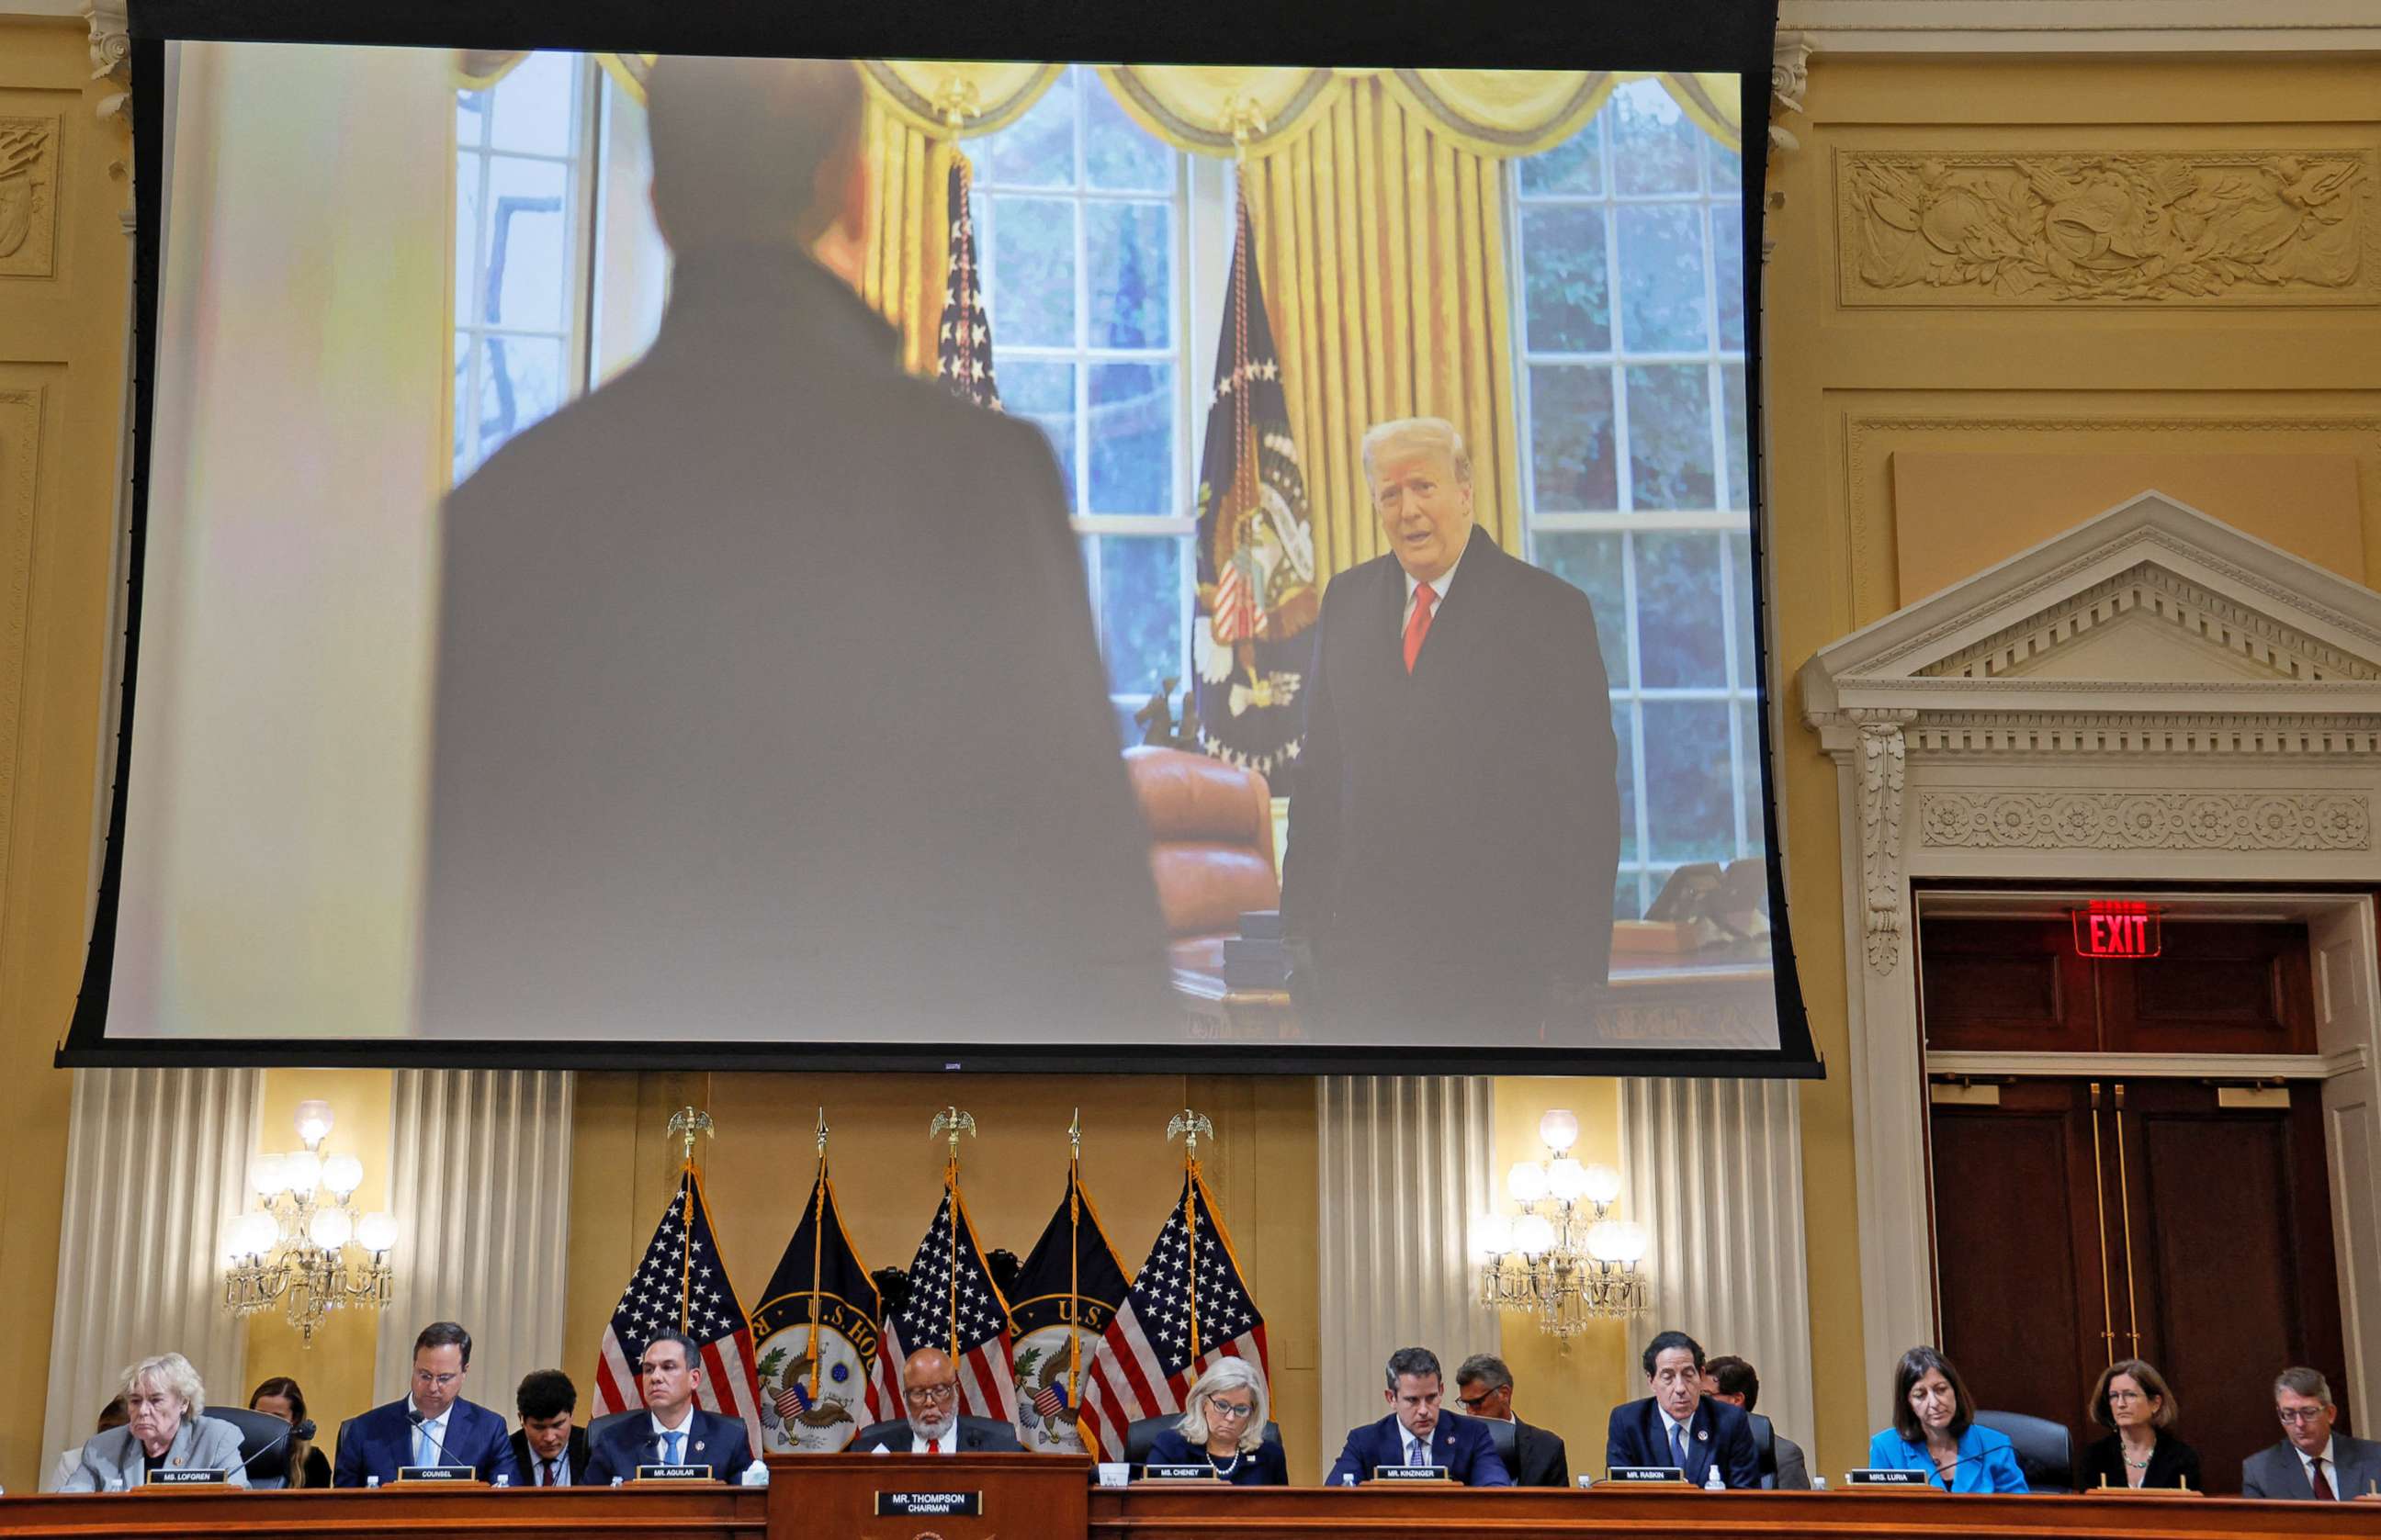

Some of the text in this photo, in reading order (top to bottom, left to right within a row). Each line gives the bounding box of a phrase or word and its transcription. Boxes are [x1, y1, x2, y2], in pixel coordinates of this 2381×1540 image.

[2090, 915, 2148, 953] EXIT
[177, 1472, 210, 1480] LOFGREN
[893, 1494, 965, 1503] MR. THOMPSON
[908, 1504, 950, 1512] CHAIRMAN
